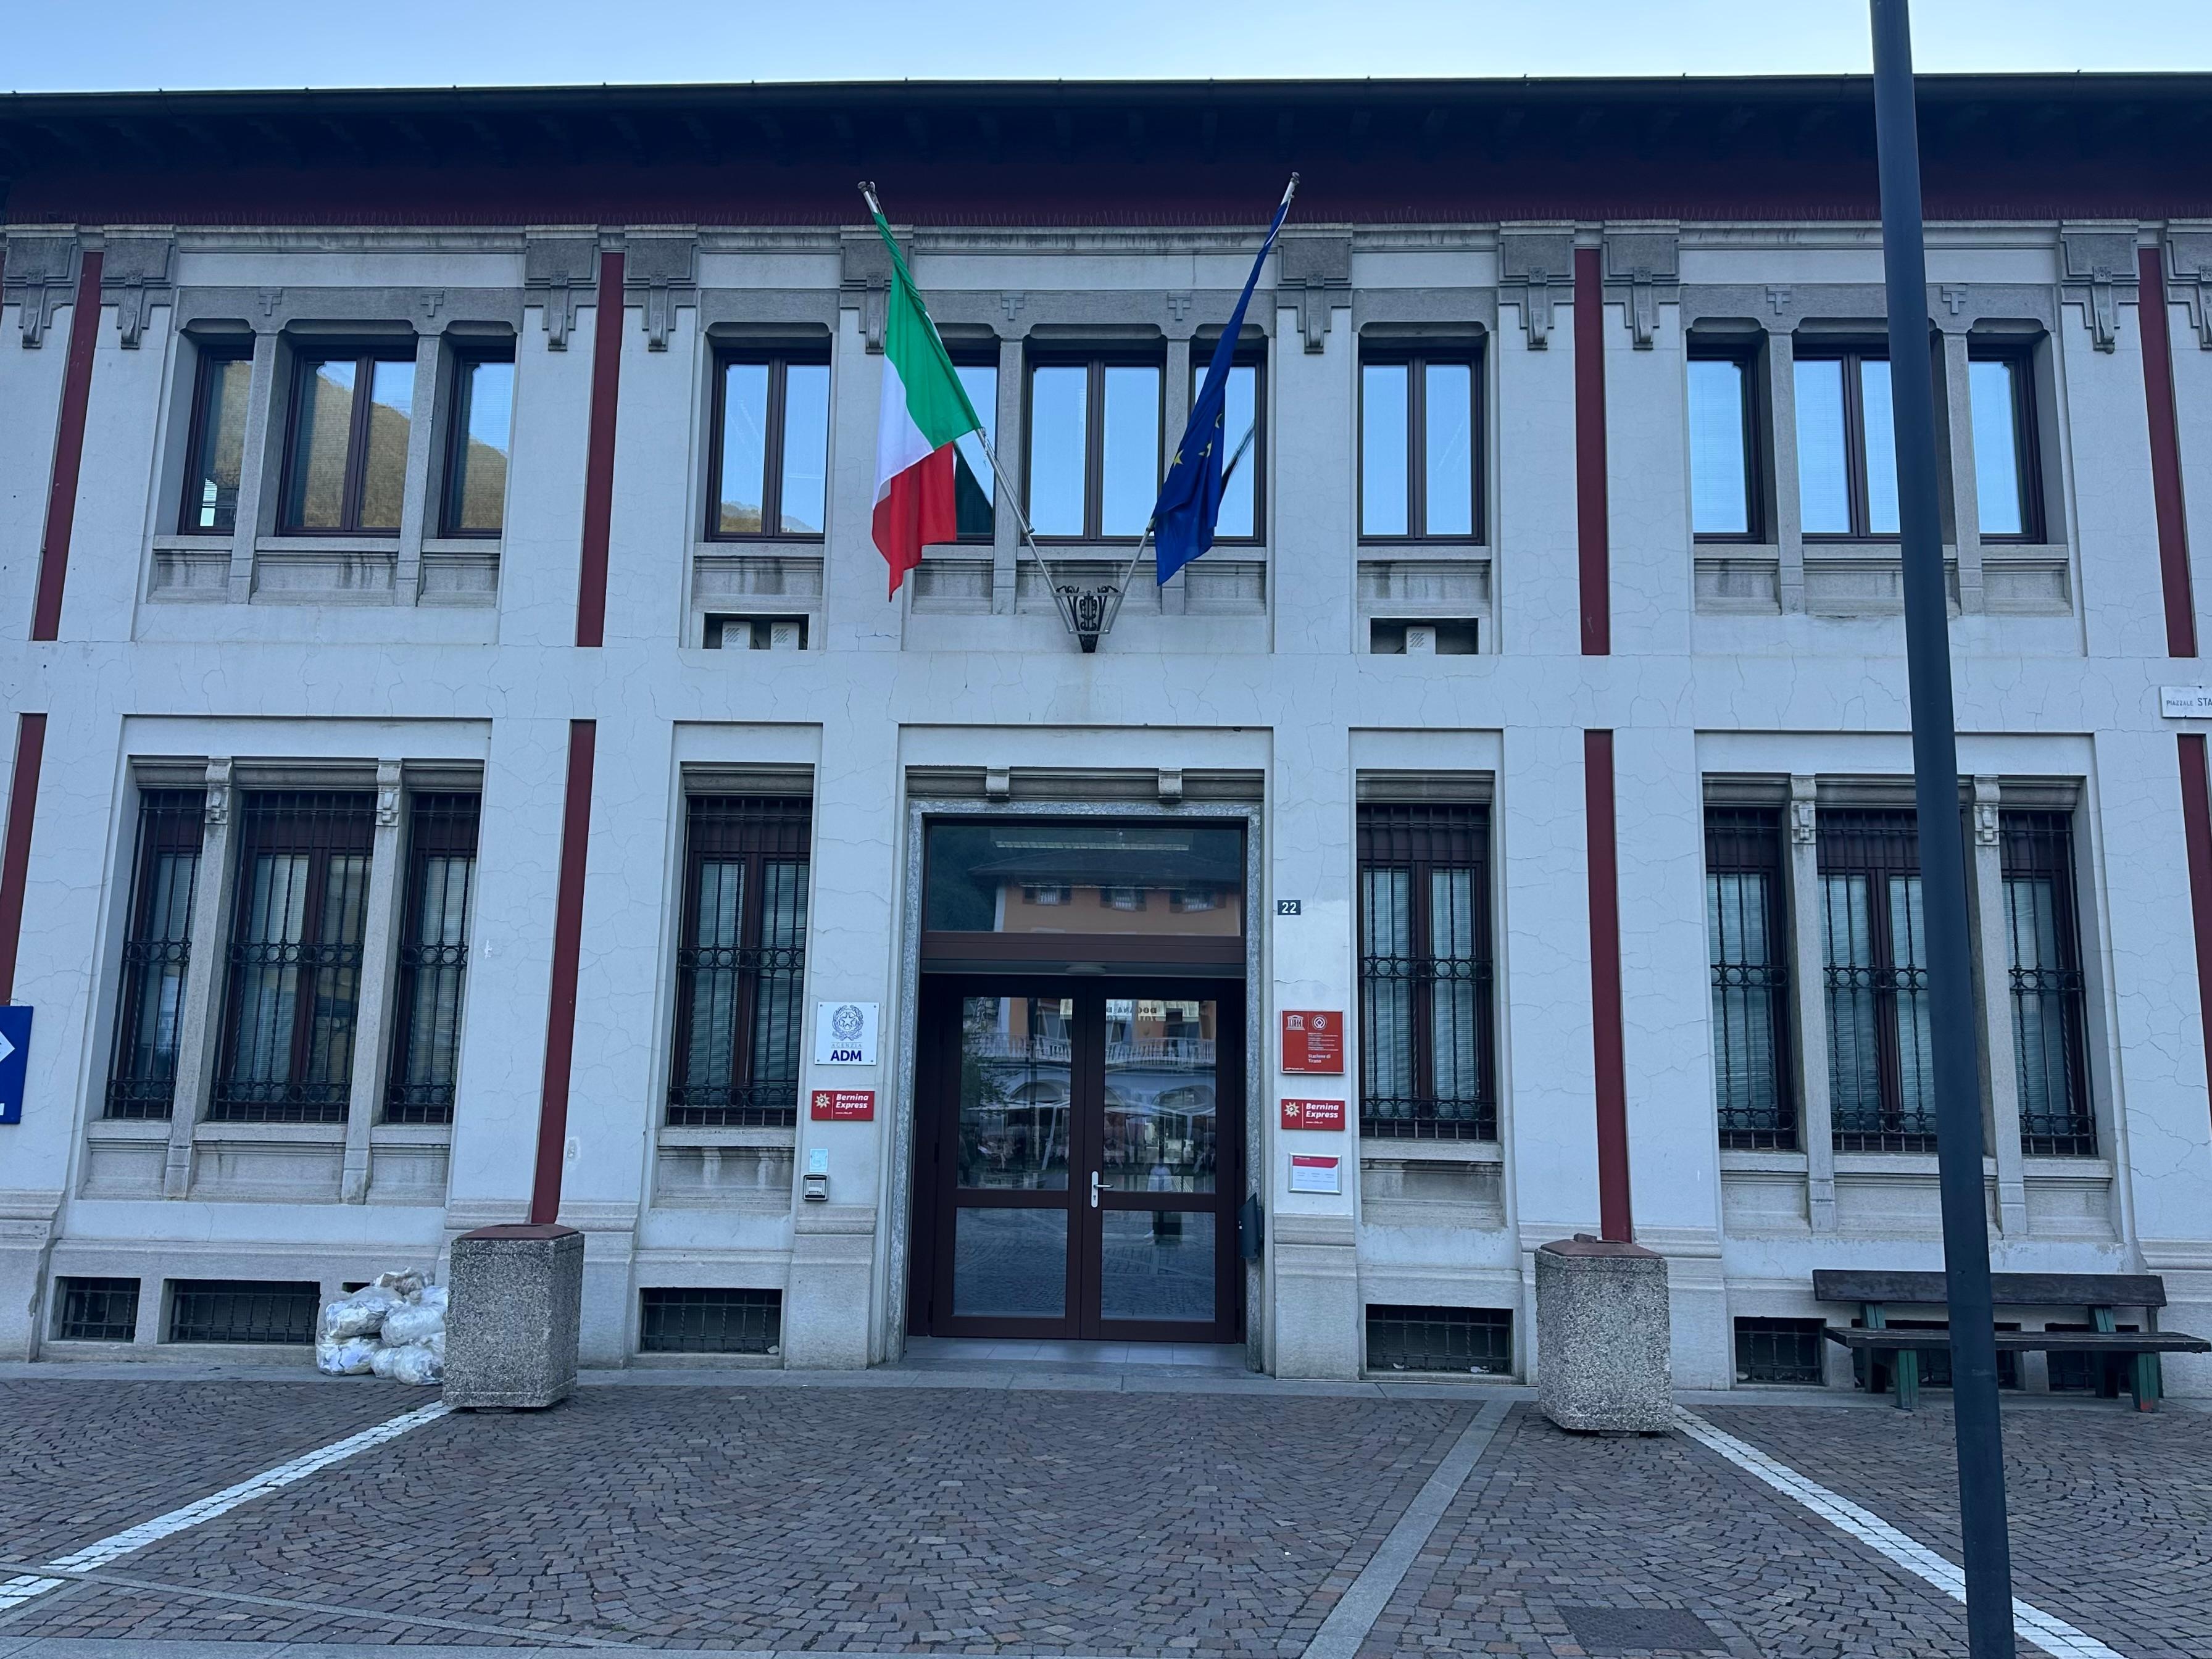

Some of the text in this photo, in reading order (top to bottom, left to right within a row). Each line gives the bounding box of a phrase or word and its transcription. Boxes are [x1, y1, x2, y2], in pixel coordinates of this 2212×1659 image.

[1281, 902, 1297, 913] 22
[830, 1050, 862, 1061] ADM
[836, 1102, 868, 1110] Express
[1306, 1111, 1338, 1119] Express
